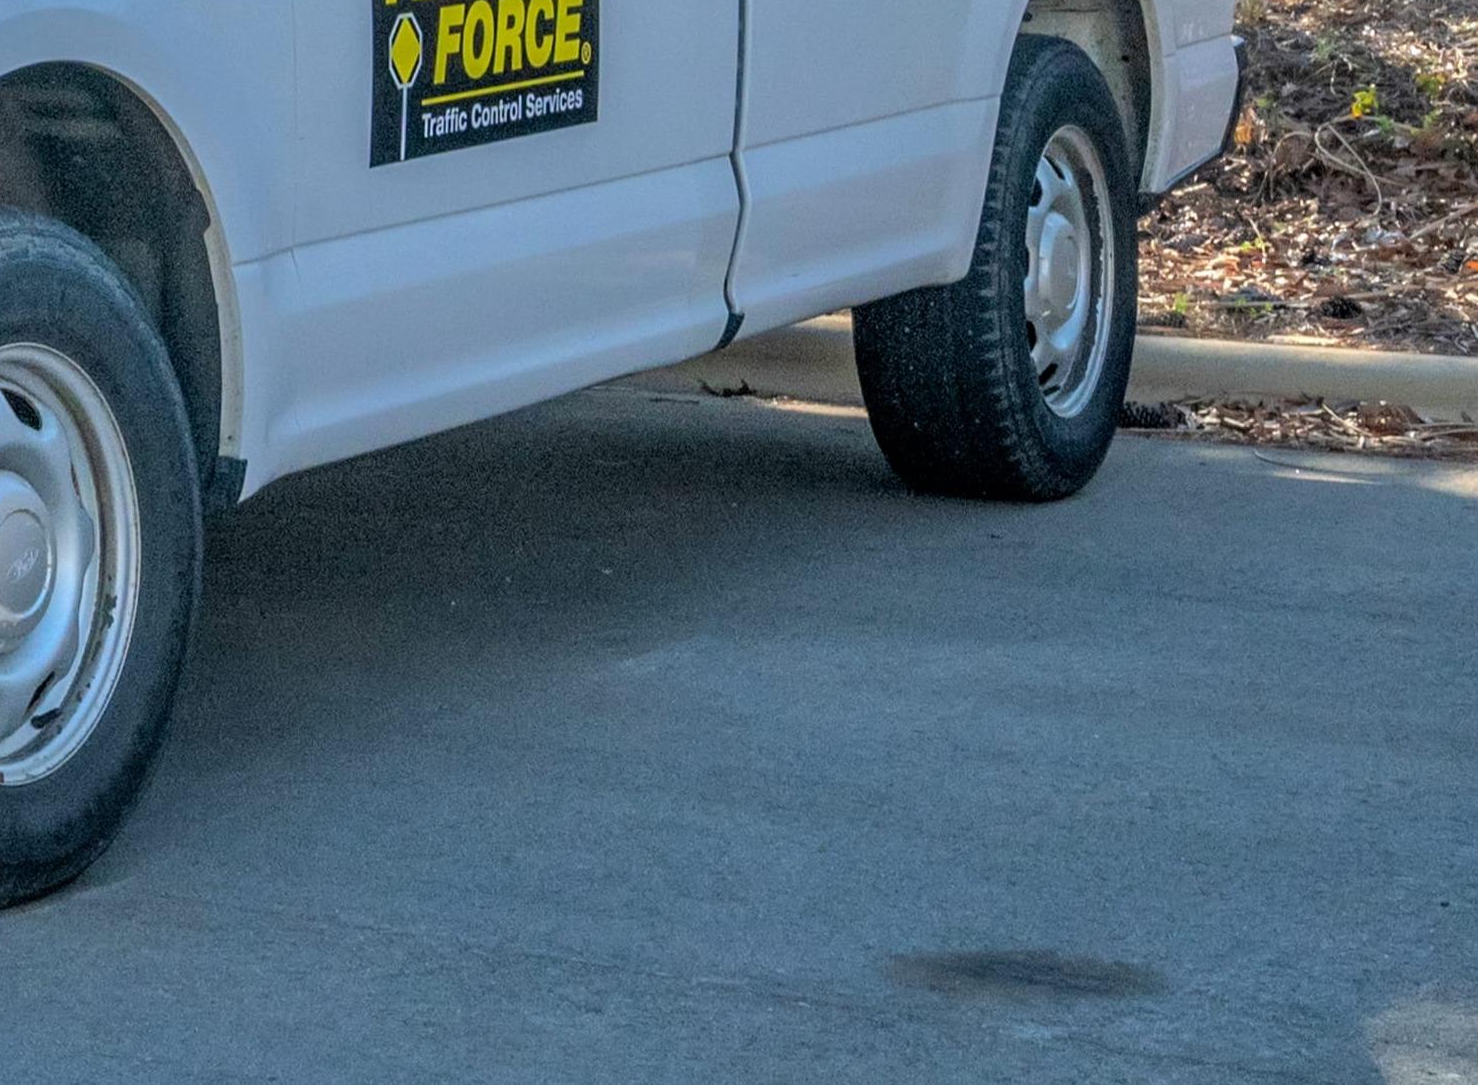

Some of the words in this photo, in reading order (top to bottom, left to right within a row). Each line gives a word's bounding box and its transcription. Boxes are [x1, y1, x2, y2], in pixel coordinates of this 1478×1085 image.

[421, 112, 467, 138] Traffic
[471, 97, 522, 128] Control
[526, 88, 583, 117] Services
